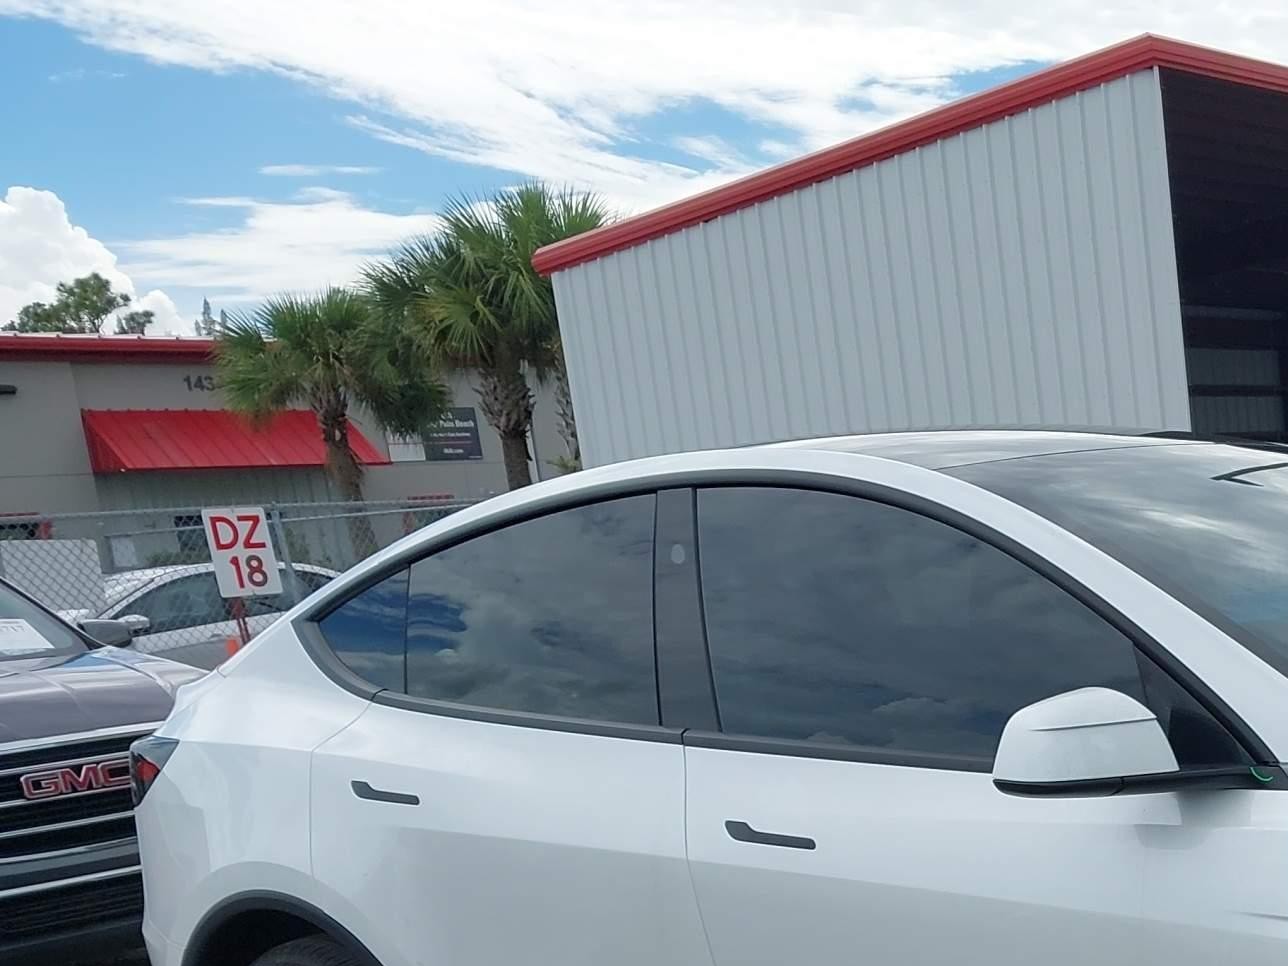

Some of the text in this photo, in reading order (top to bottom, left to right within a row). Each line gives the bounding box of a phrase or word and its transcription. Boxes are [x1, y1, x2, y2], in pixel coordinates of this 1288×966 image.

[184, 375, 220, 392] 143
[208, 514, 267, 551] DZ
[229, 554, 269, 589] 18
[20, 758, 132, 800] GMC
